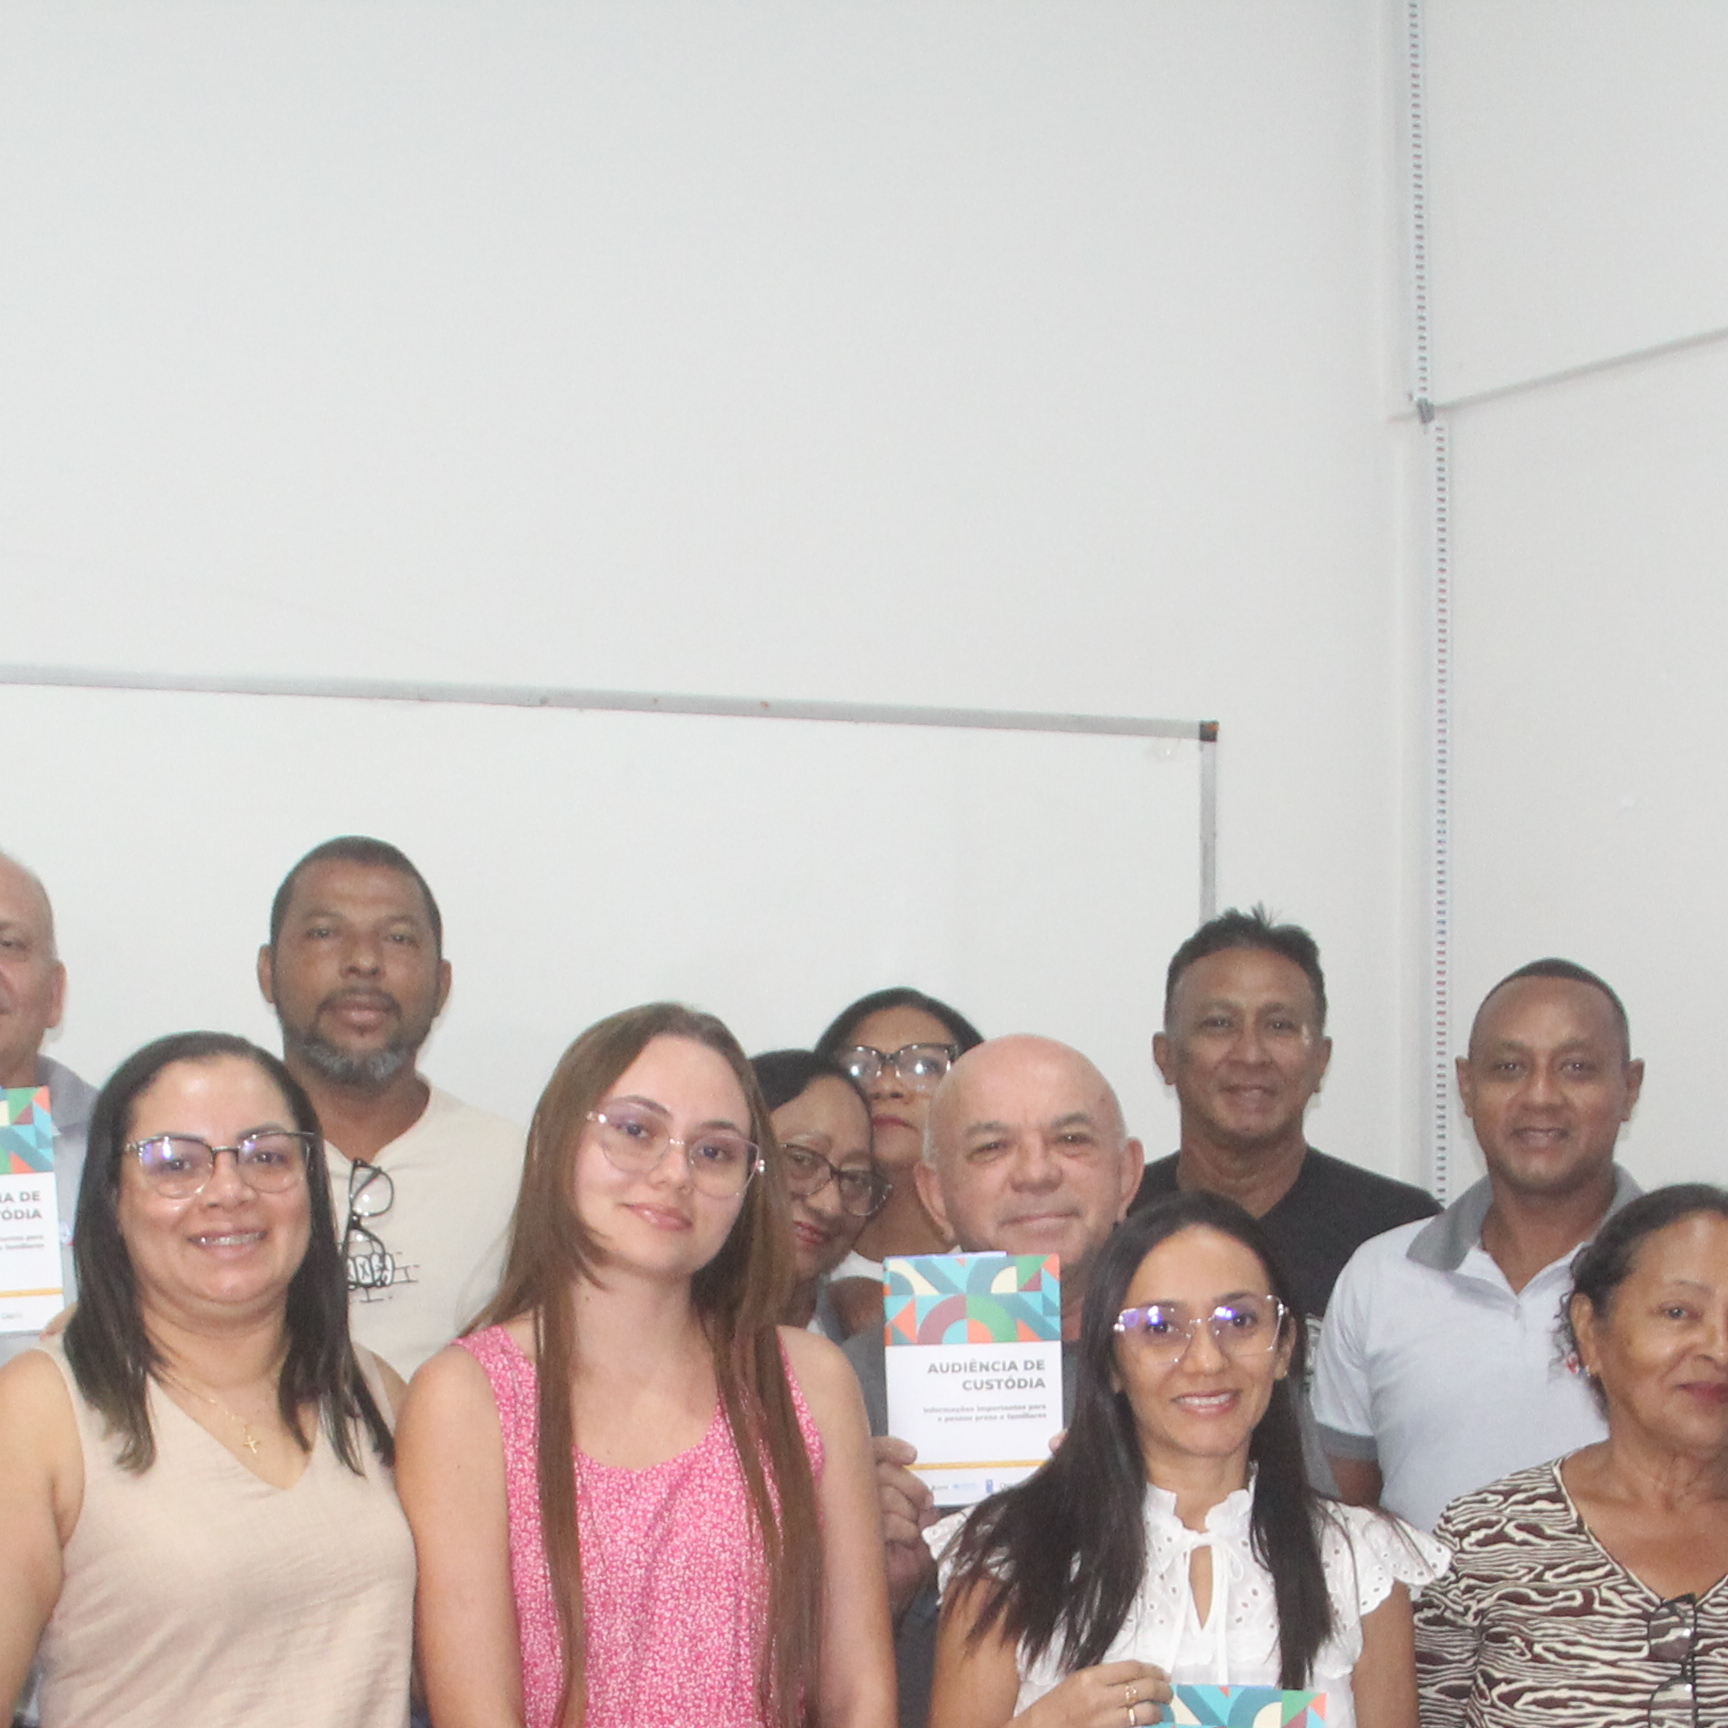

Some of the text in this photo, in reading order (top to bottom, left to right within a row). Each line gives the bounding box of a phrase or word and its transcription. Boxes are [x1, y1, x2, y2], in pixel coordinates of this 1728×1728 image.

[19, 1190, 41, 1202] DE
[927, 1358, 1046, 1374] AUDIÊNCIA DE
[962, 1375, 1046, 1391] CUSTÓDIA
